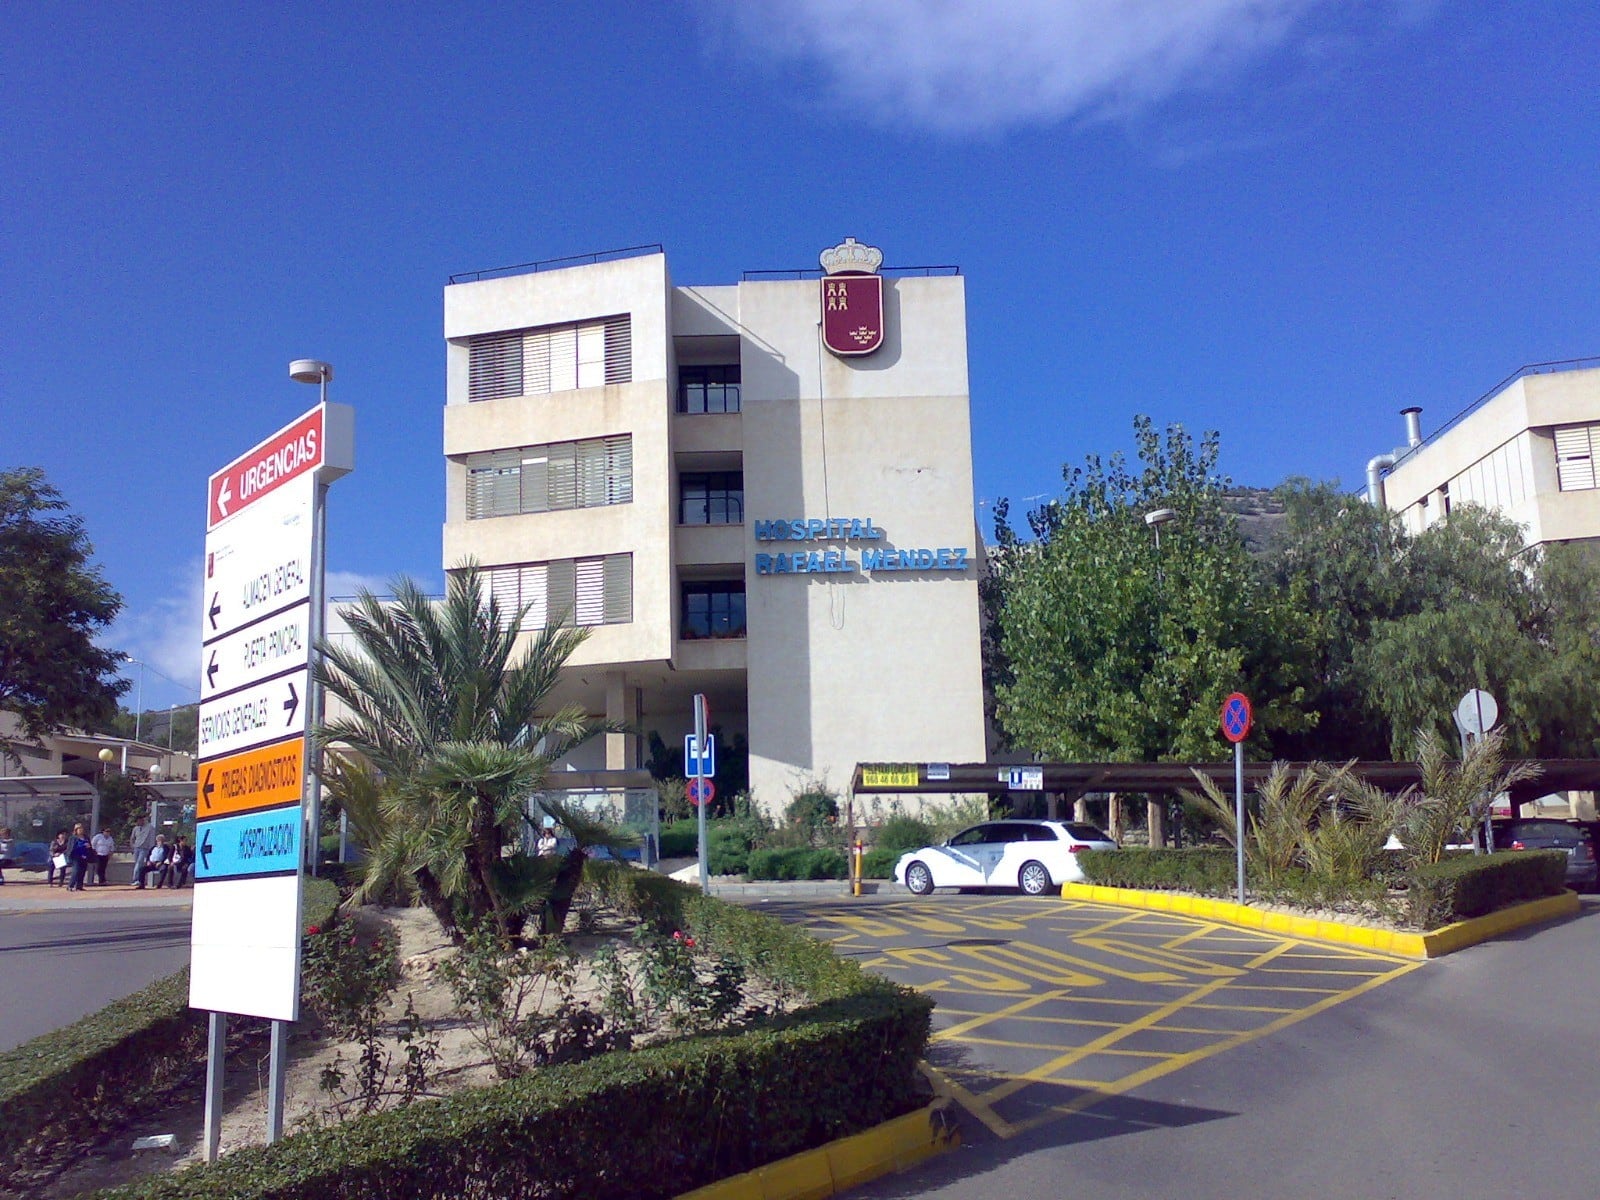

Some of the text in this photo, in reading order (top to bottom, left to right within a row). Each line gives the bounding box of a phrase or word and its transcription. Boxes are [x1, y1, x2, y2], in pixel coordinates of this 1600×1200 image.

[239, 428, 316, 500] URGENCIAS
[755, 517, 881, 541] HOSPITAL
[274, 557, 304, 597] GENERAL
[755, 547, 969, 575] RAFAEL MENDEZ
[244, 622, 302, 670] PUERTA PRINCIPAL
[201, 697, 269, 745] SERVICIOS GENERALES
[221, 766, 247, 800] PRUEBAS
[808, 905, 1027, 937] BUS
[883, 937, 1250, 991] SOLO
